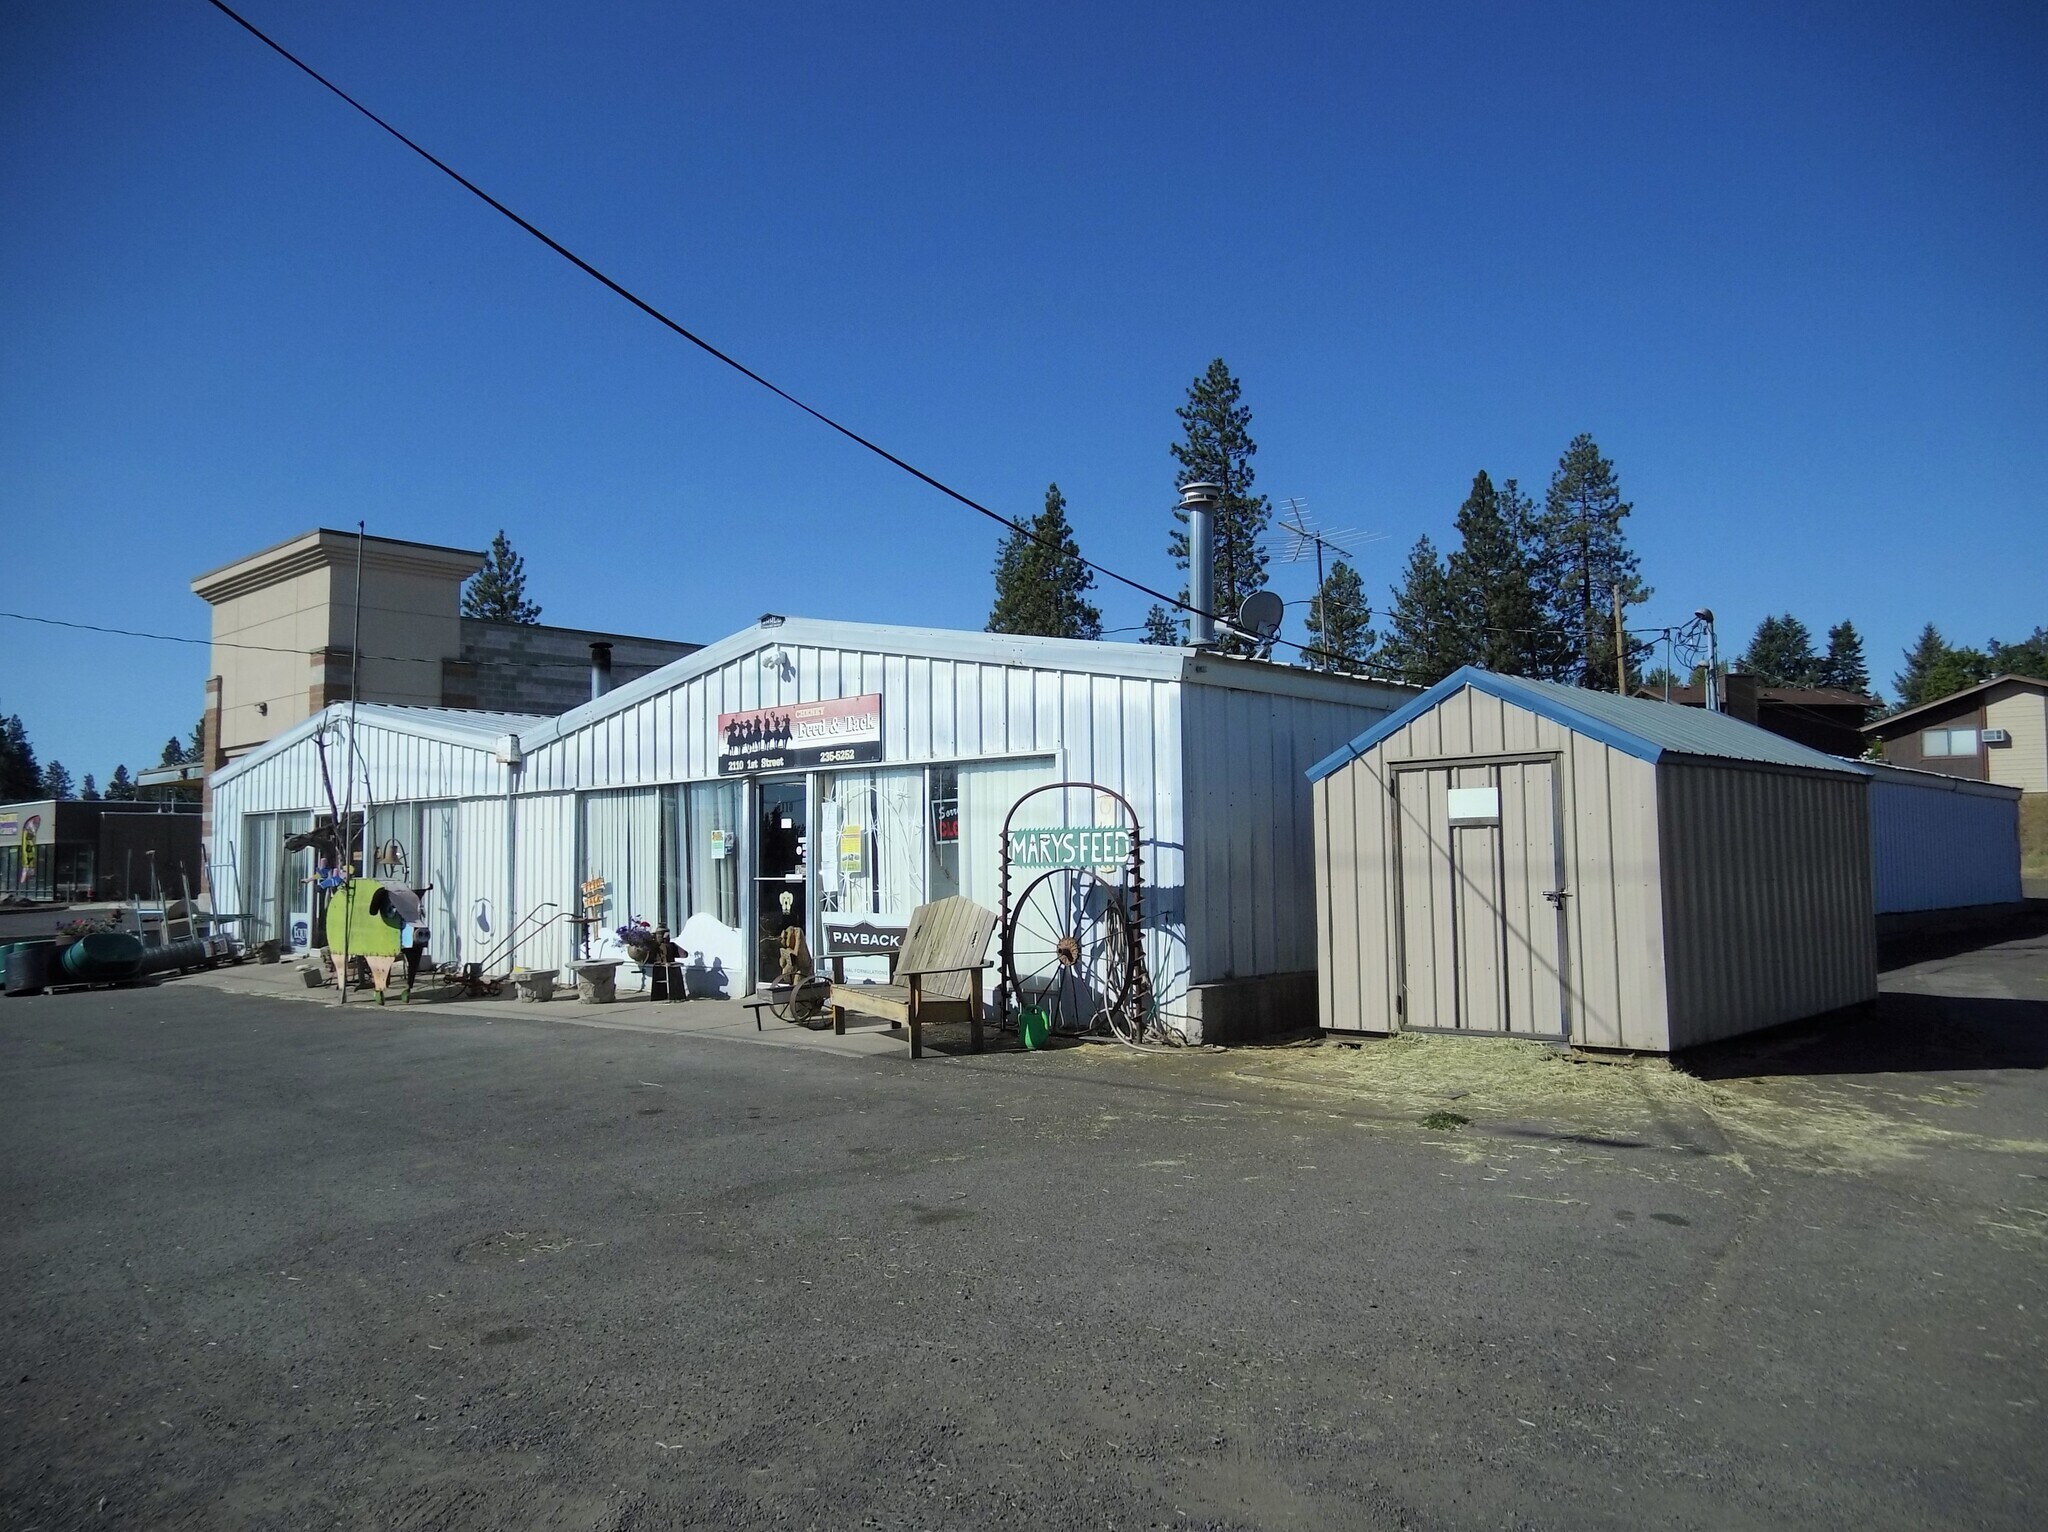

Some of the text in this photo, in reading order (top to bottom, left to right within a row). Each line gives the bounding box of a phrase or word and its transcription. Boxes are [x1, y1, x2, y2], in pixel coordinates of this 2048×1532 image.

[798, 713, 875, 738] Feed & Tack
[820, 749, 854, 762] 235-5252
[728, 757, 784, 771] 2110 1st Street
[938, 806, 958, 820] Sorr
[585, 896, 601, 906] TACK
[833, 931, 900, 947] PAYBACK
